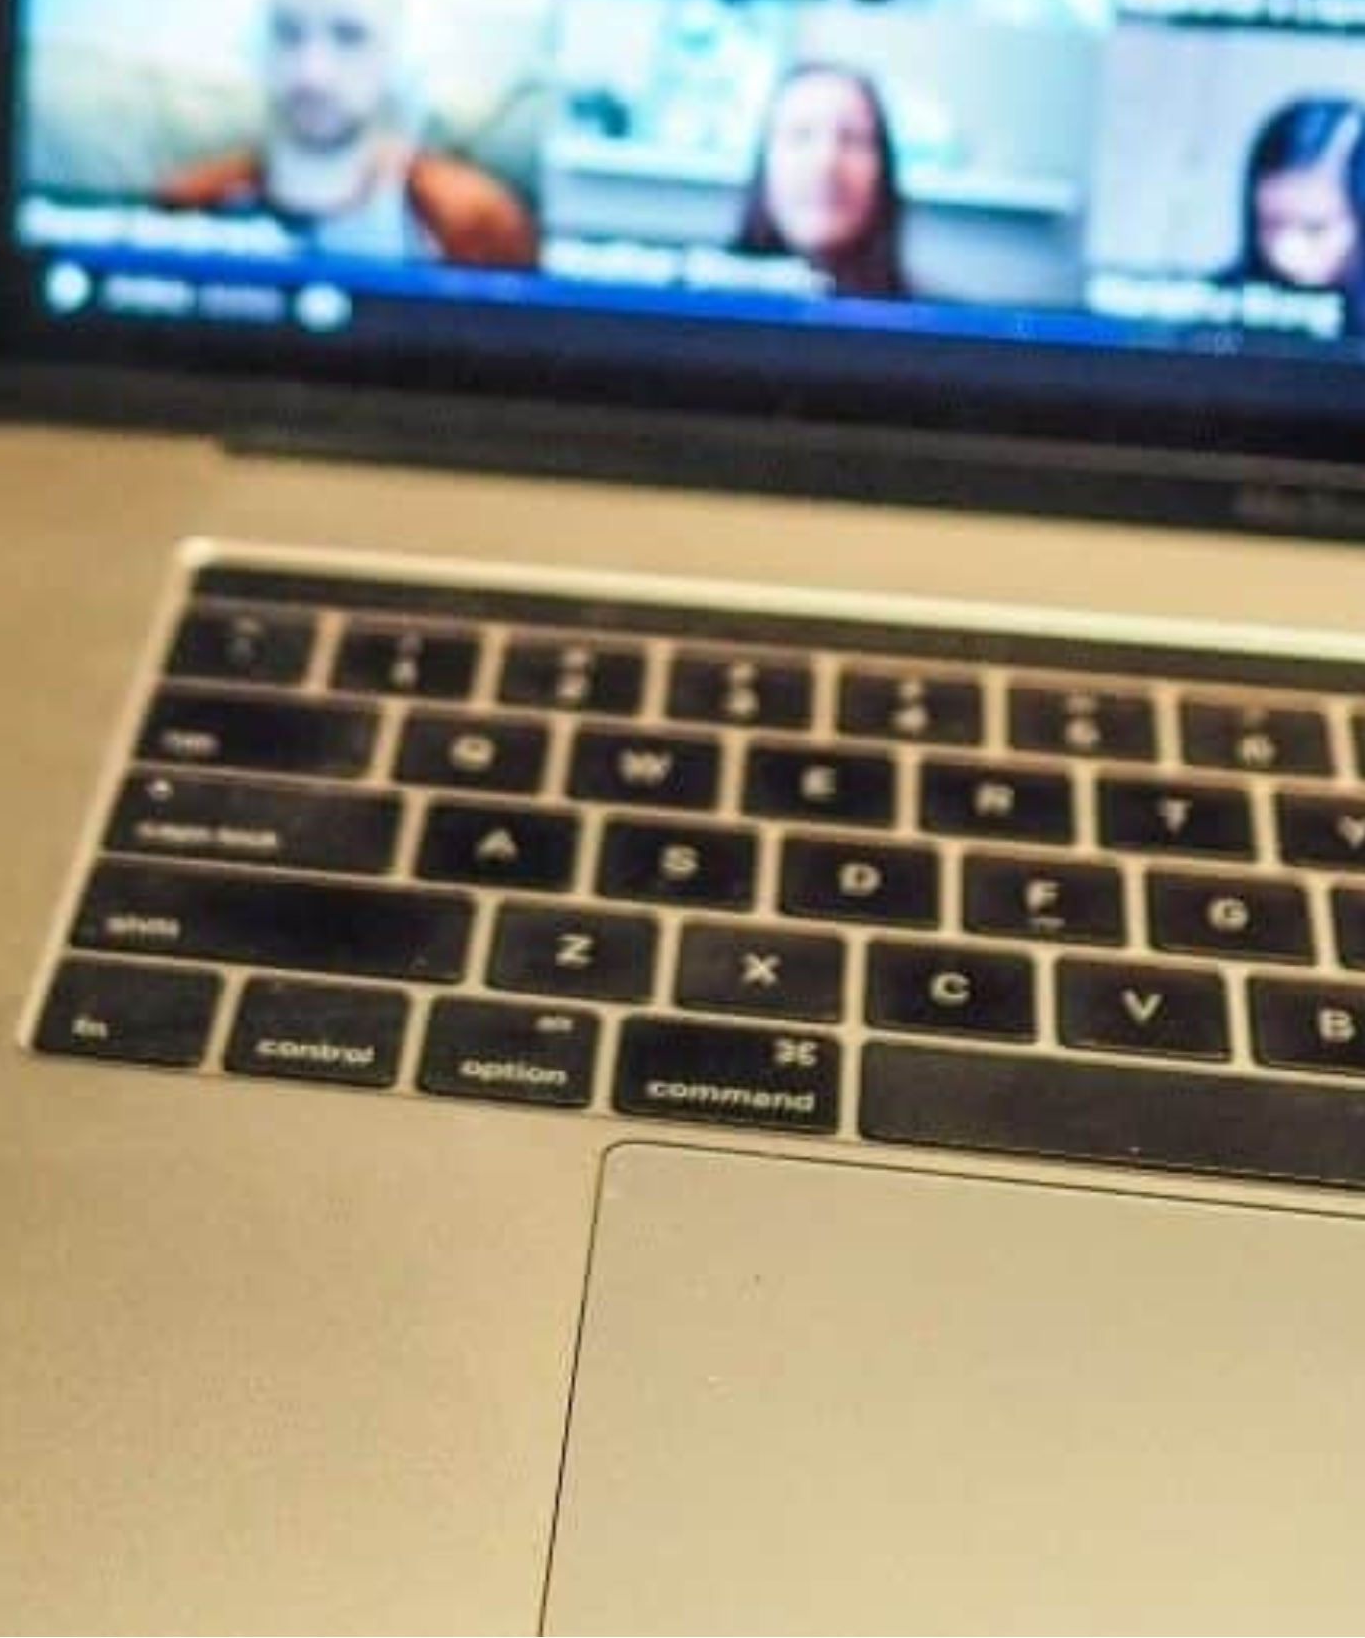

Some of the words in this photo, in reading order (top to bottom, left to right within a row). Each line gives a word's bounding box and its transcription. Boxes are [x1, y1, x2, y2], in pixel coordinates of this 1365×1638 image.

[1025, 879, 1060, 909] F
[1208, 897, 1249, 930] G
[556, 933, 593, 965] Z
[744, 953, 778, 984] X
[930, 971, 969, 1003] C
[1123, 990, 1162, 1022] V
[1317, 1008, 1356, 1041] B
[255, 1036, 375, 1066] control
[459, 1059, 568, 1088] option
[644, 1080, 816, 1112] command
